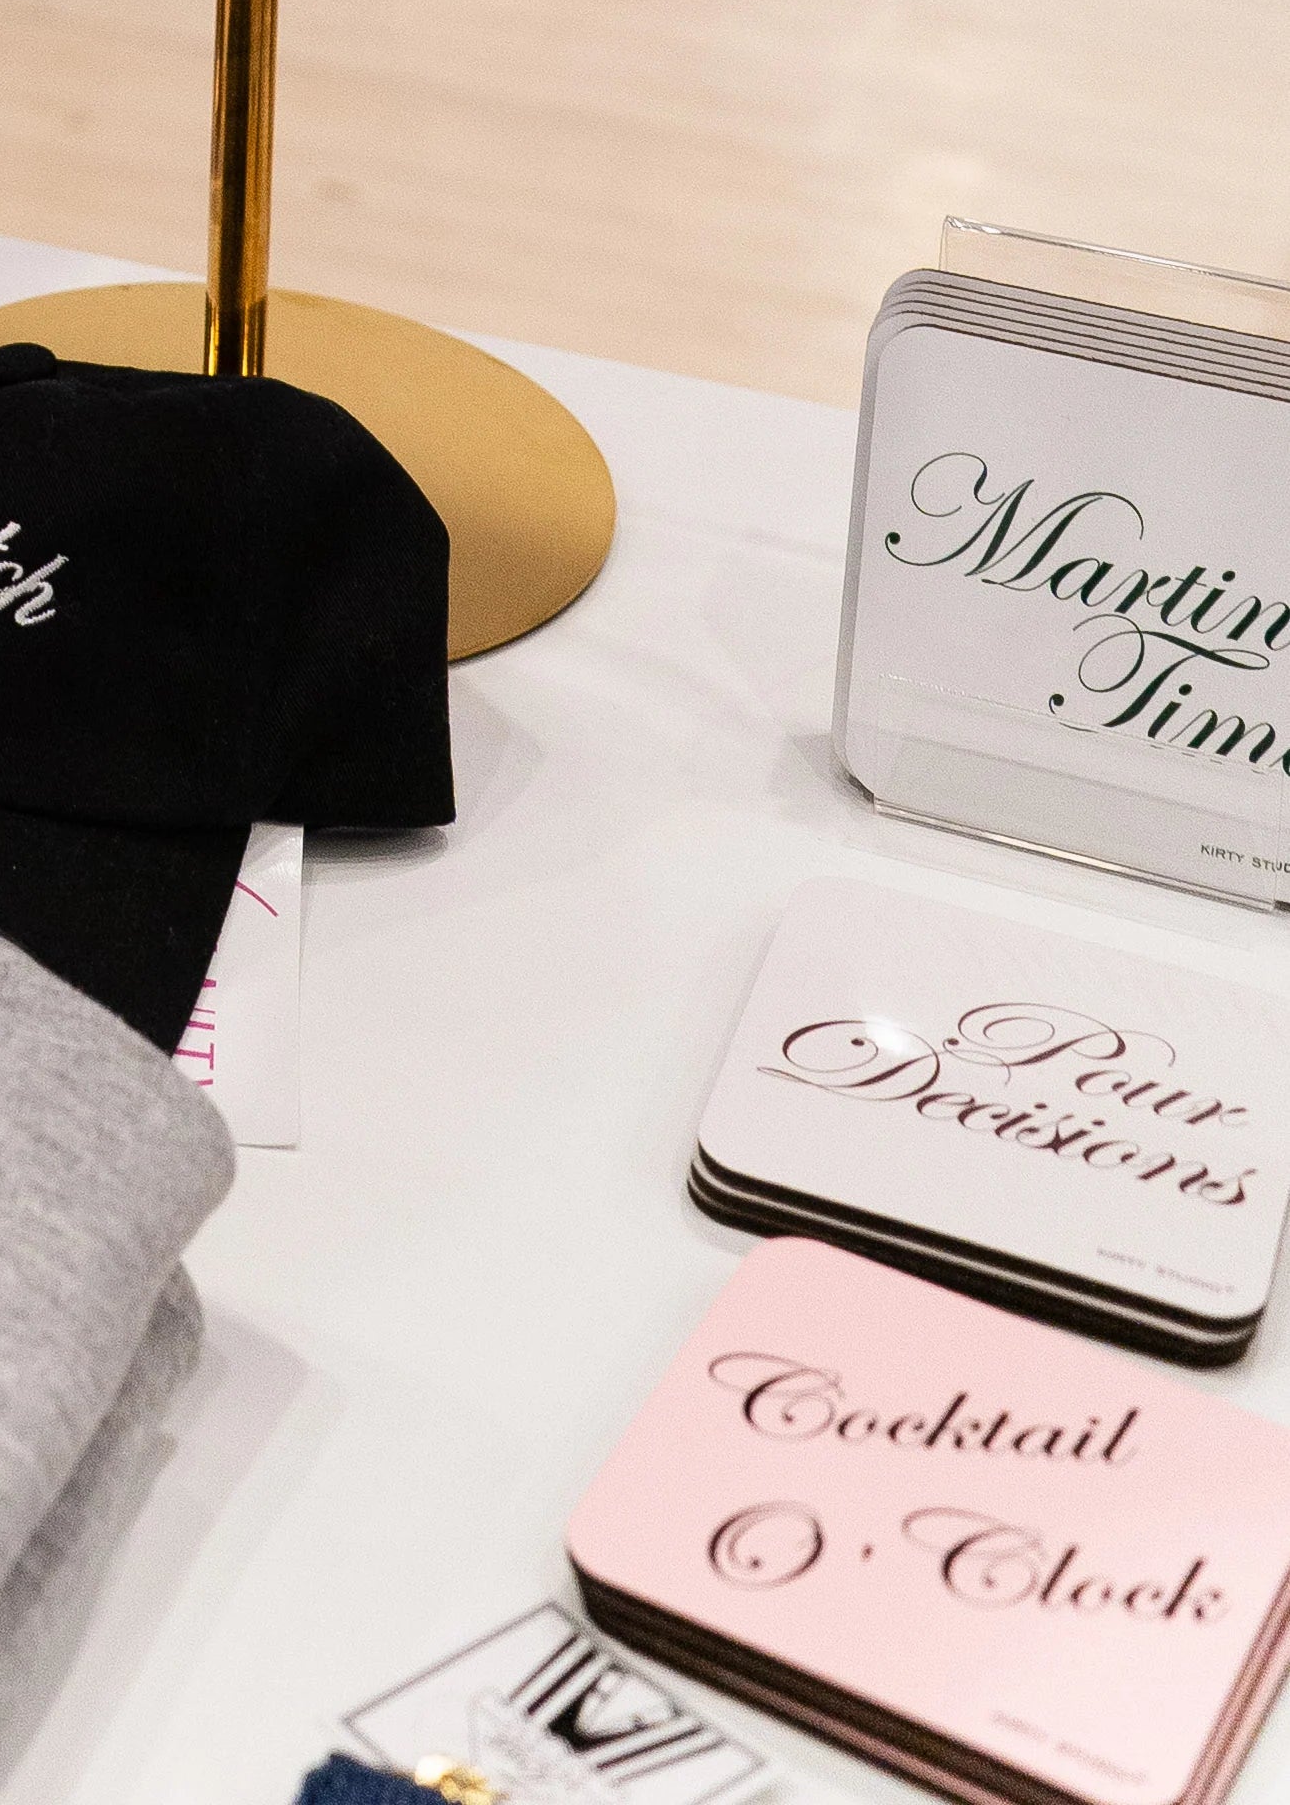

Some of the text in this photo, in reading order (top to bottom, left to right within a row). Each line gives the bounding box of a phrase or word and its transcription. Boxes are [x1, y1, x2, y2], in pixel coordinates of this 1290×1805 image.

[1201, 844, 1244, 863] KIRTY
[756, 1019, 1259, 1206] Decisions
[942, 1001, 1248, 1127] Pour
[708, 1350, 1142, 1466] Cocktail
